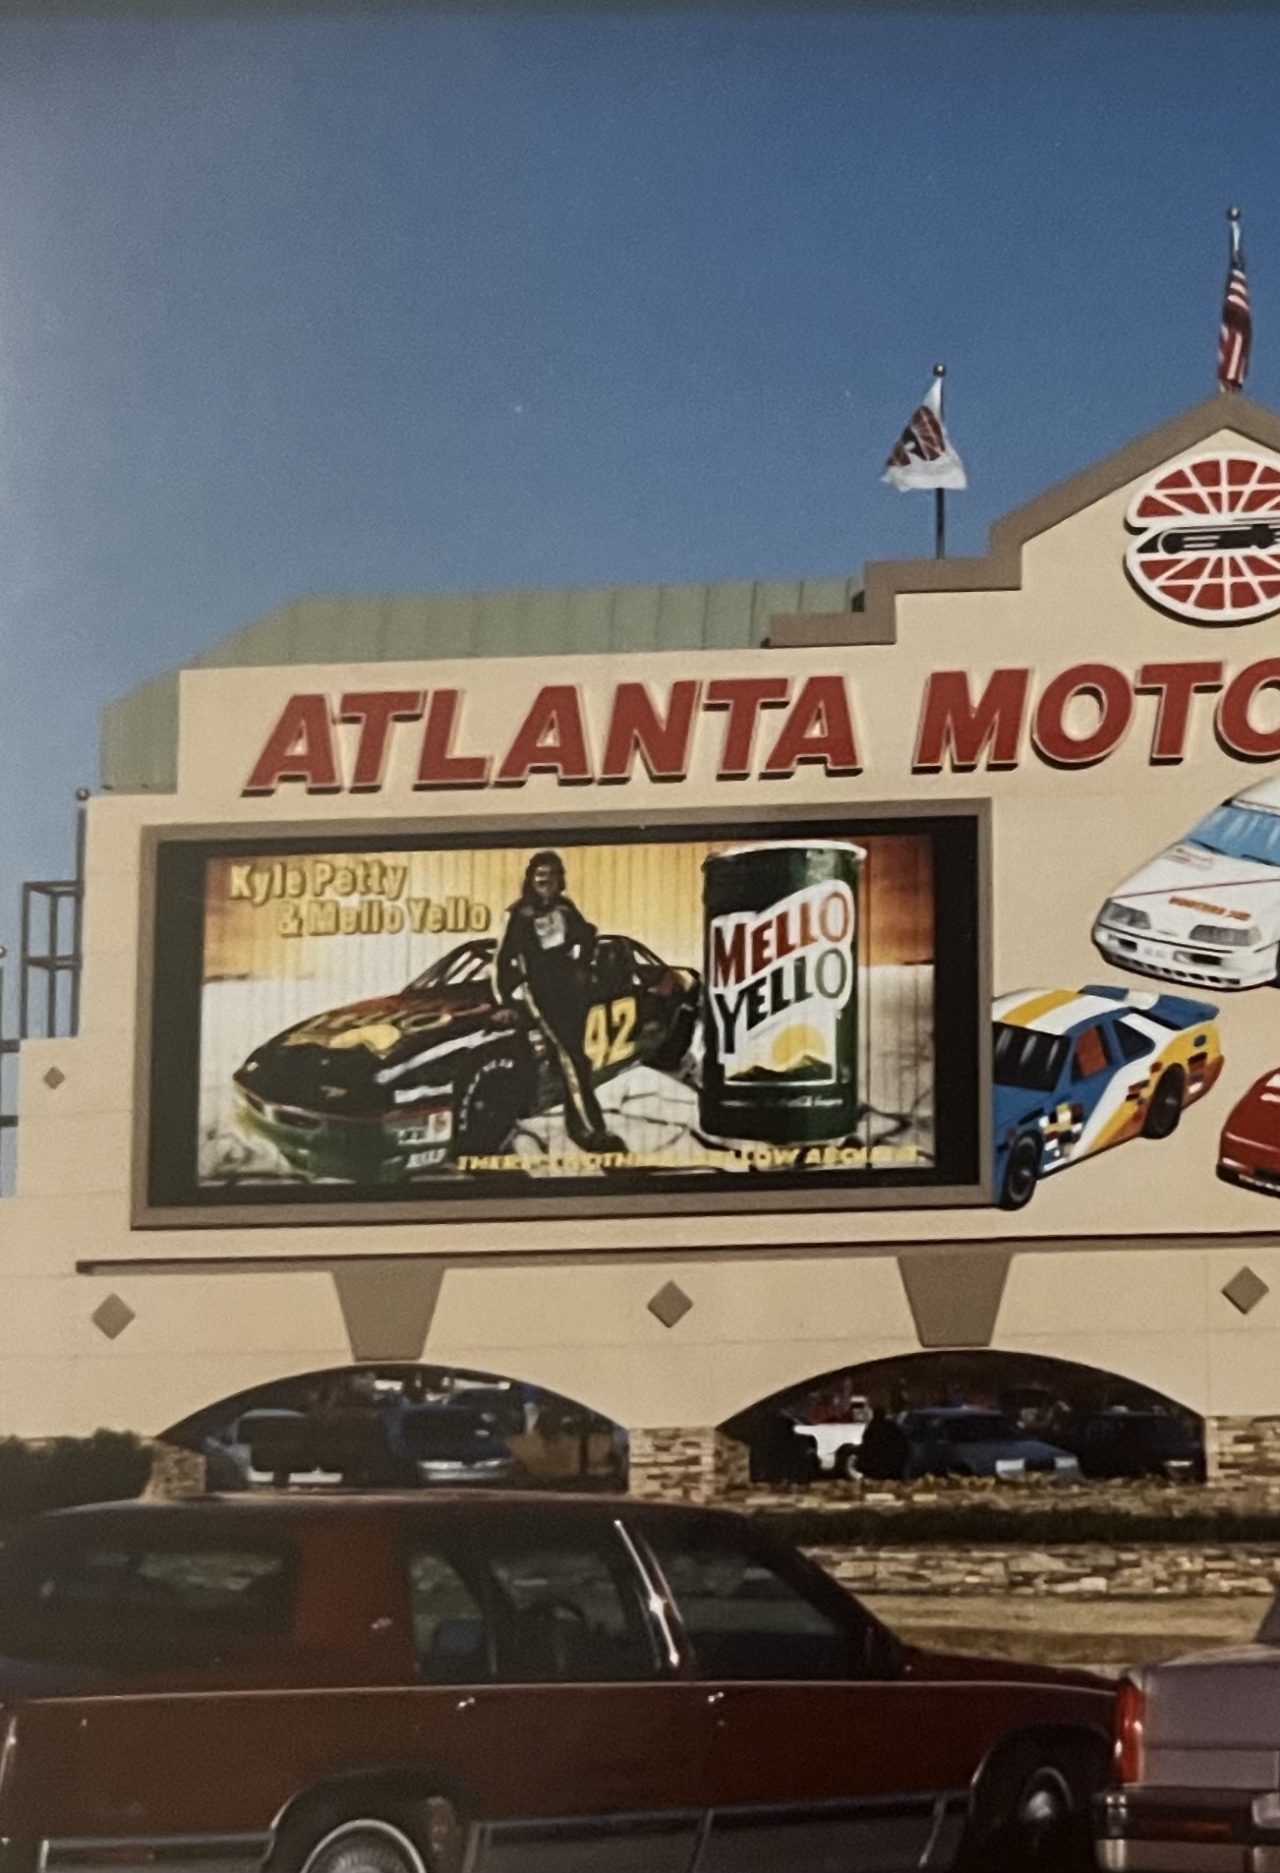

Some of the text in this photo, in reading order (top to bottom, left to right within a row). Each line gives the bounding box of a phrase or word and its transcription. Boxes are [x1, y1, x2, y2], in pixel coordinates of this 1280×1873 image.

[243, 675, 860, 796] ATLANTA
[230, 860, 408, 906] Kyle Petty
[406, 896, 491, 934] Yello
[714, 890, 849, 988] MELLO
[584, 996, 637, 1071] 42
[714, 947, 847, 1055] YELLO
